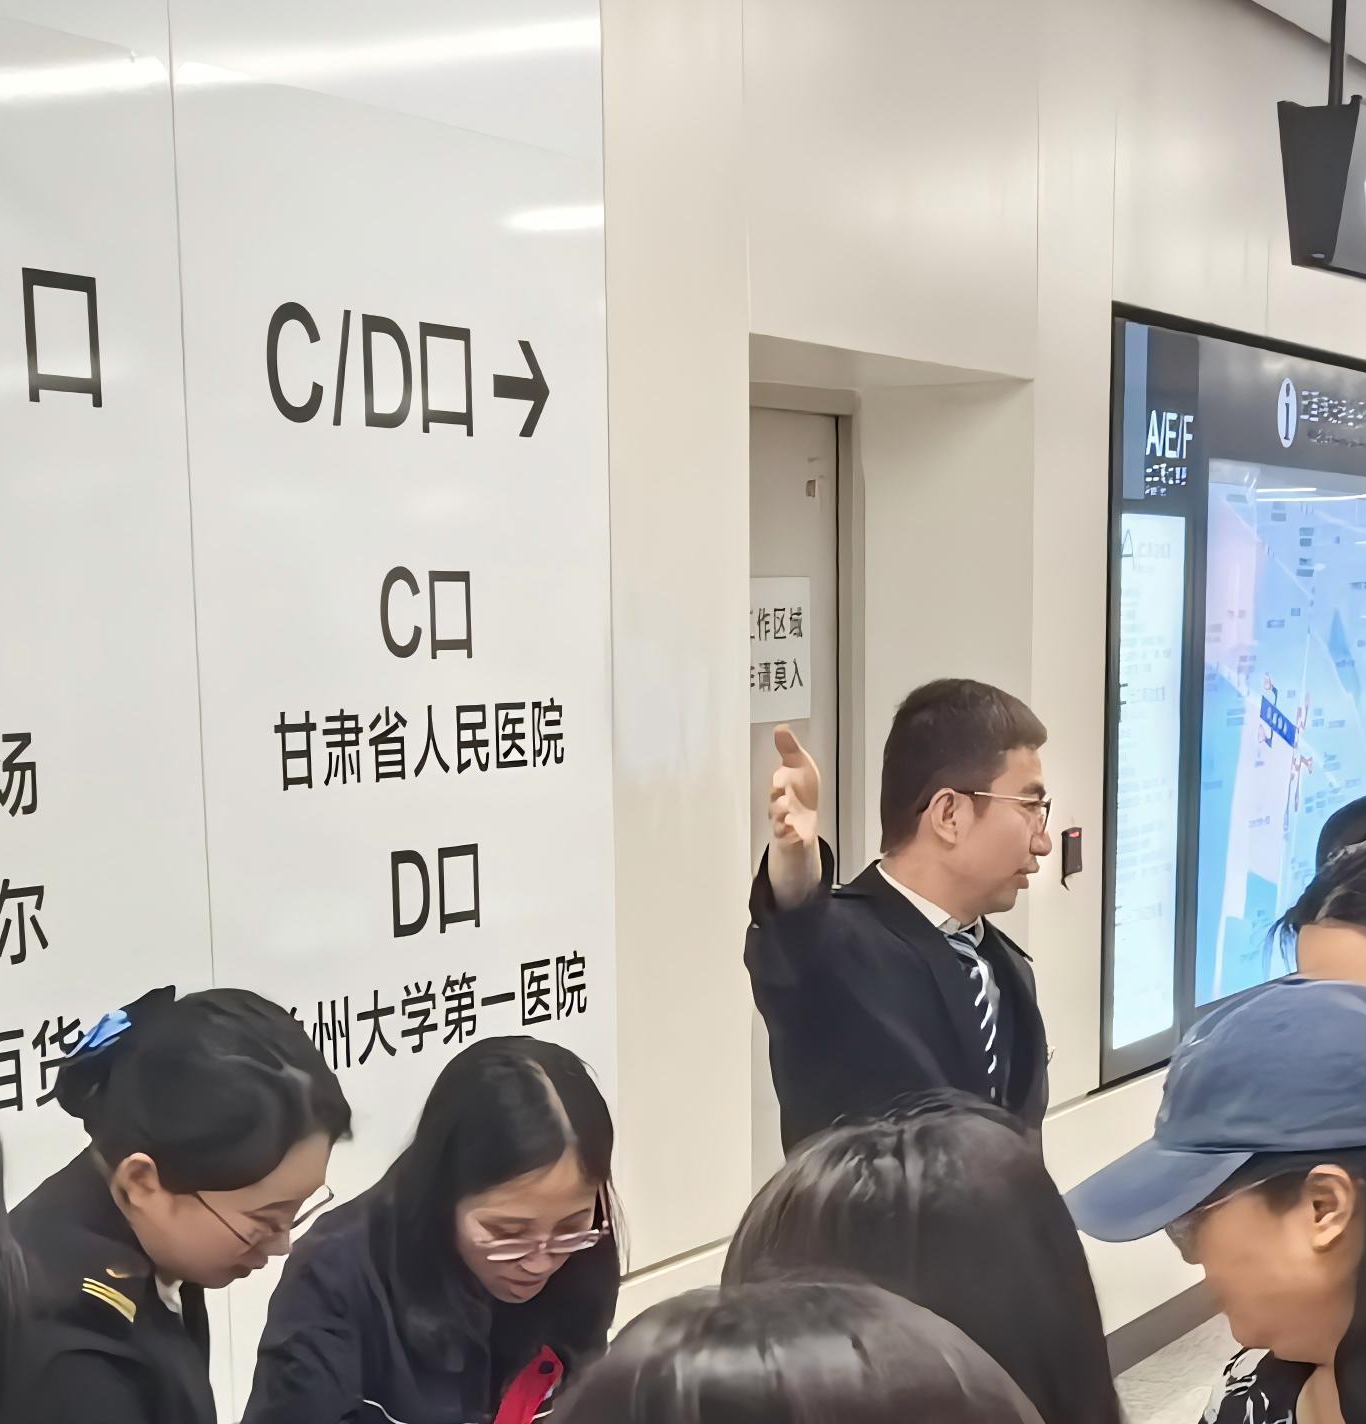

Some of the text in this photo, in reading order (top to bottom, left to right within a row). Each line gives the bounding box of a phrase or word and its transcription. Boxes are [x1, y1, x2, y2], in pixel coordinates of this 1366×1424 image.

[266, 301, 474, 437] C/D口
[380, 566, 473, 660] C口
[273, 697, 565, 792] 甘肃省人民医院
[390, 843, 481, 938] D口
[290, 950, 588, 1070] 州大学第一医院
